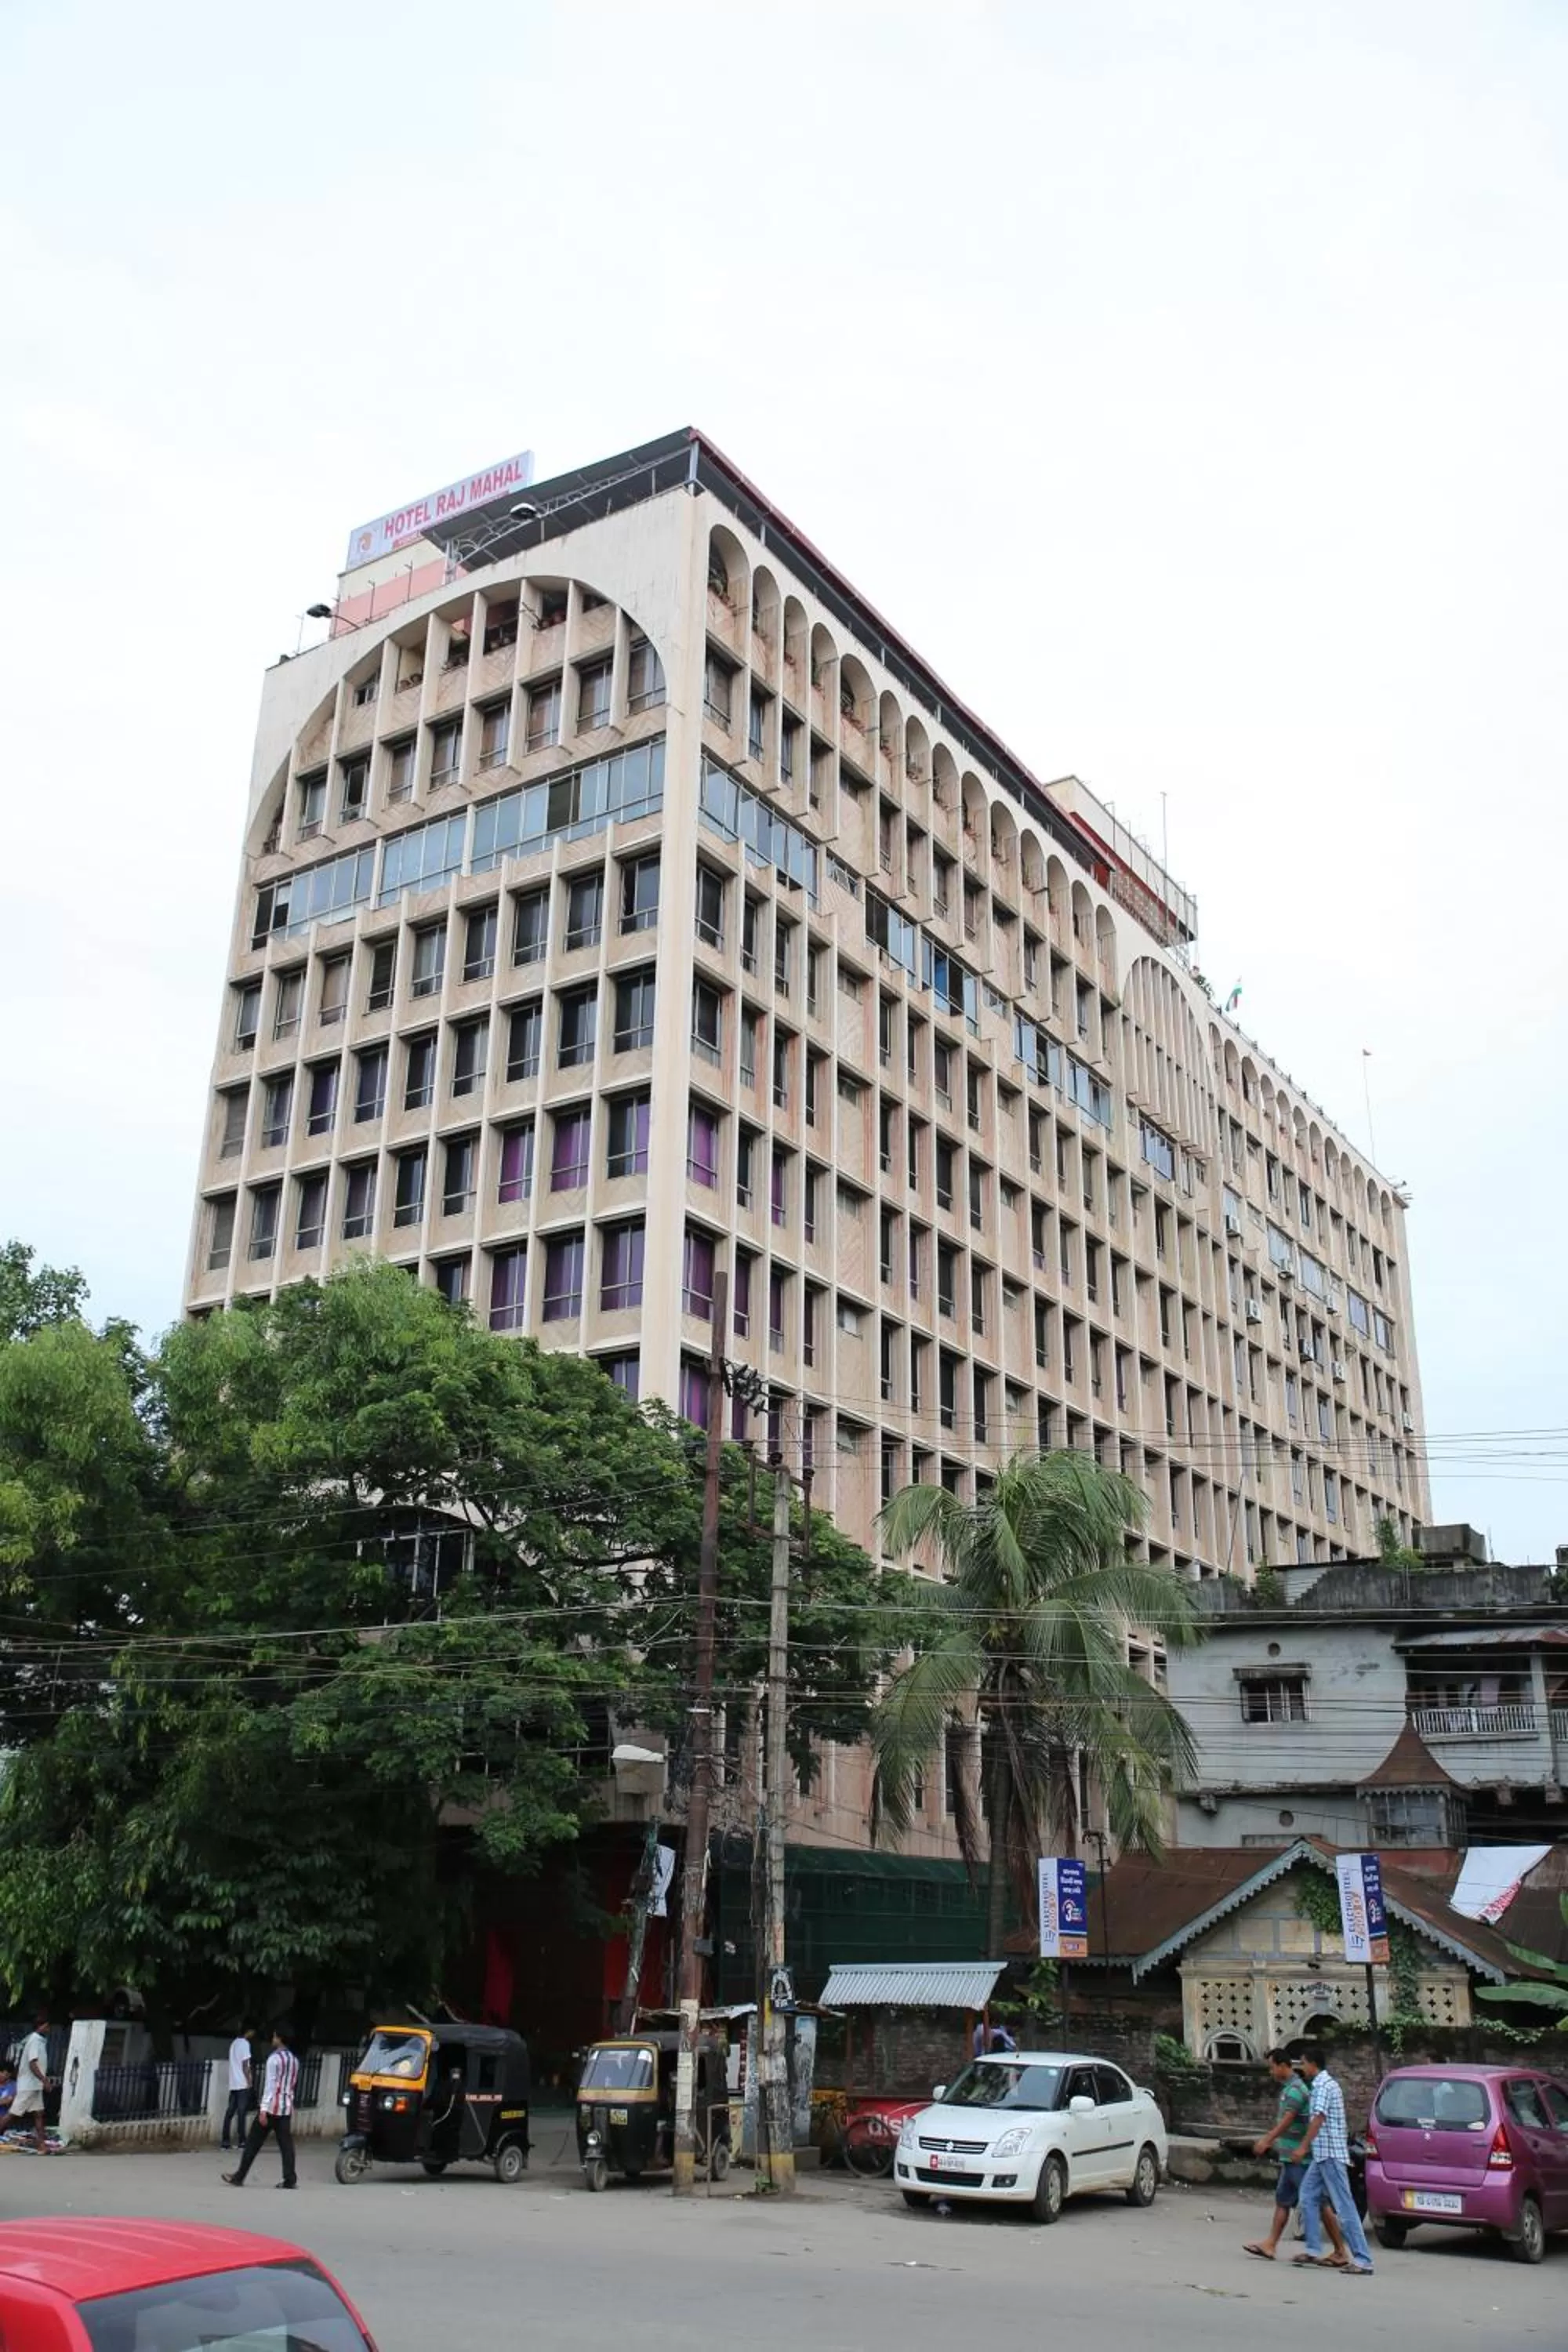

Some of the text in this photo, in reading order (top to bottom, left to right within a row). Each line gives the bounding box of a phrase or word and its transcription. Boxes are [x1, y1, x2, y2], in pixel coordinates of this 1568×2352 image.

[384, 460, 522, 539] HOTEL RAJ MAHAL
[868, 2113, 908, 2136] dis
